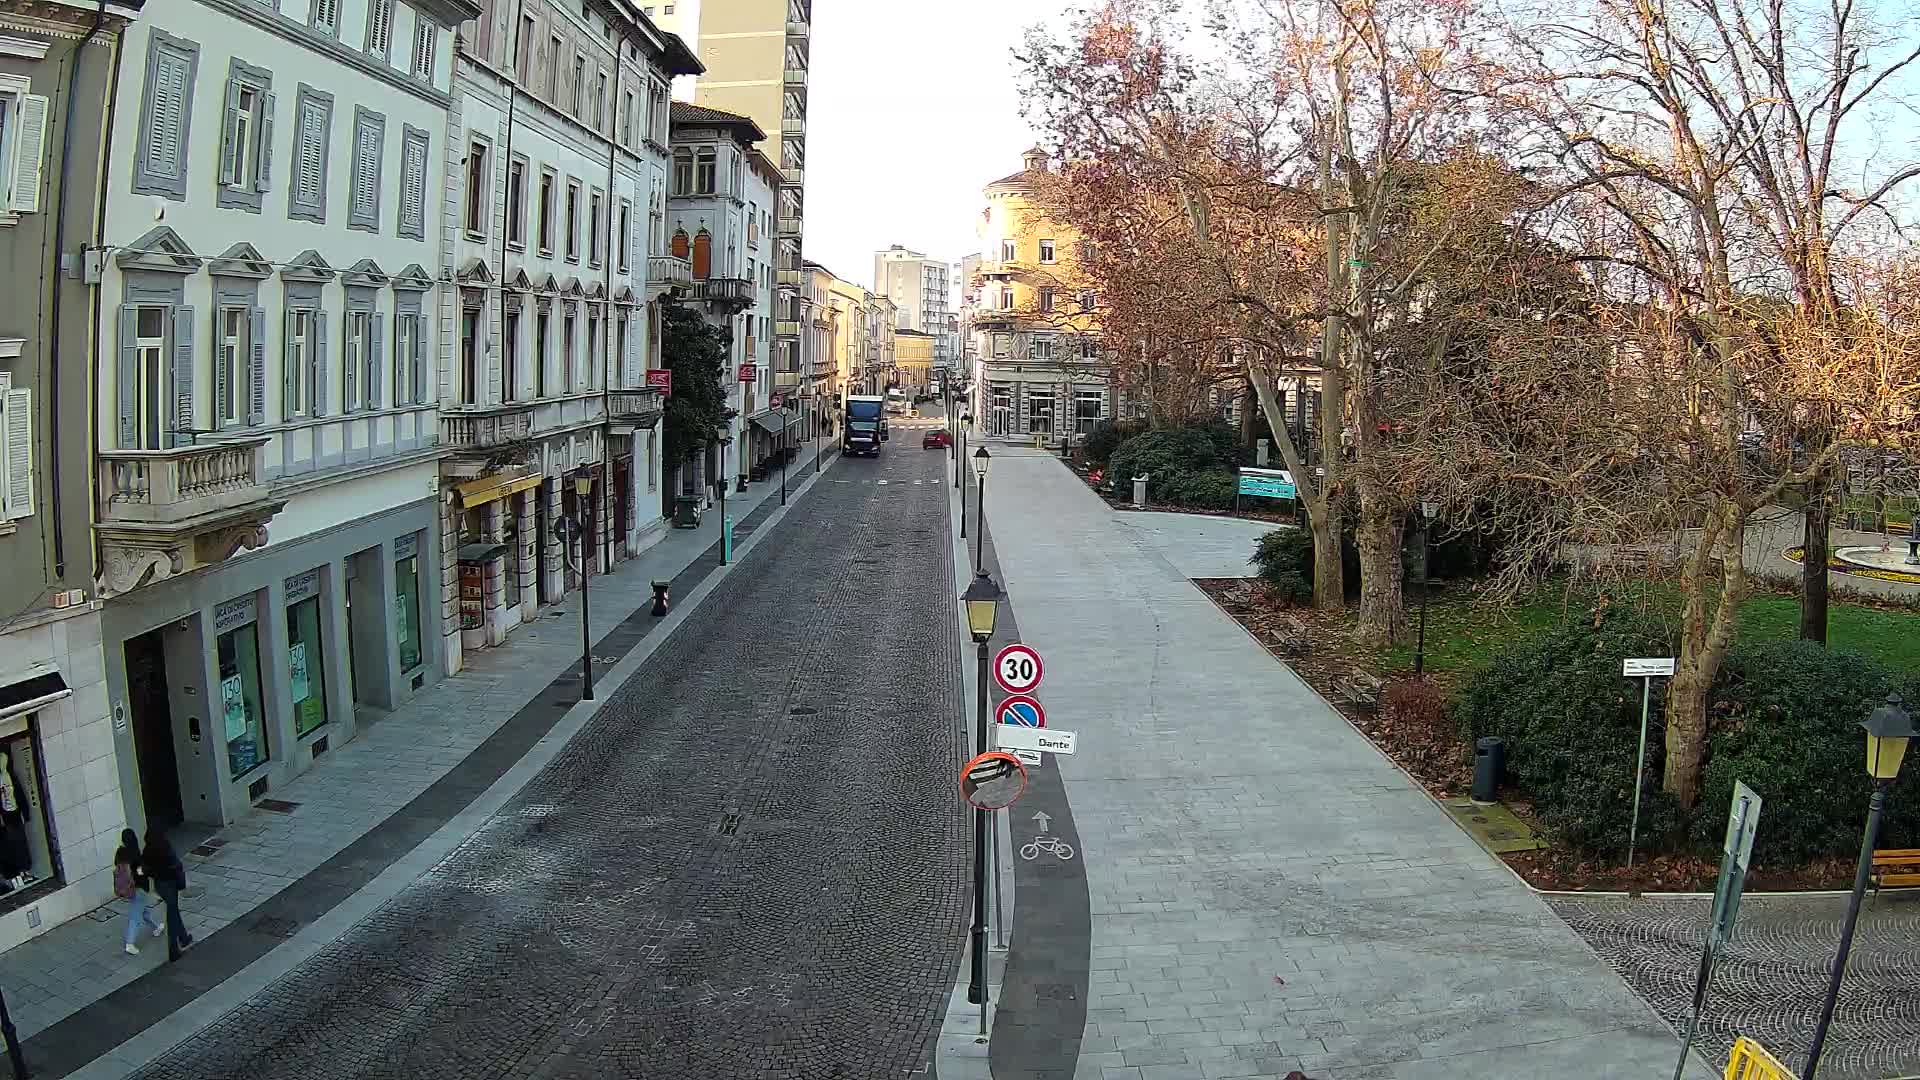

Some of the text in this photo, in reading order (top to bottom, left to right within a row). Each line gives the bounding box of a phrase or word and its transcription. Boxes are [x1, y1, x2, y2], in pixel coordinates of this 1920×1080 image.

[1005, 658, 1033, 681] 30
[223, 677, 241, 701] 130
[1038, 738, 1070, 749] Dante
